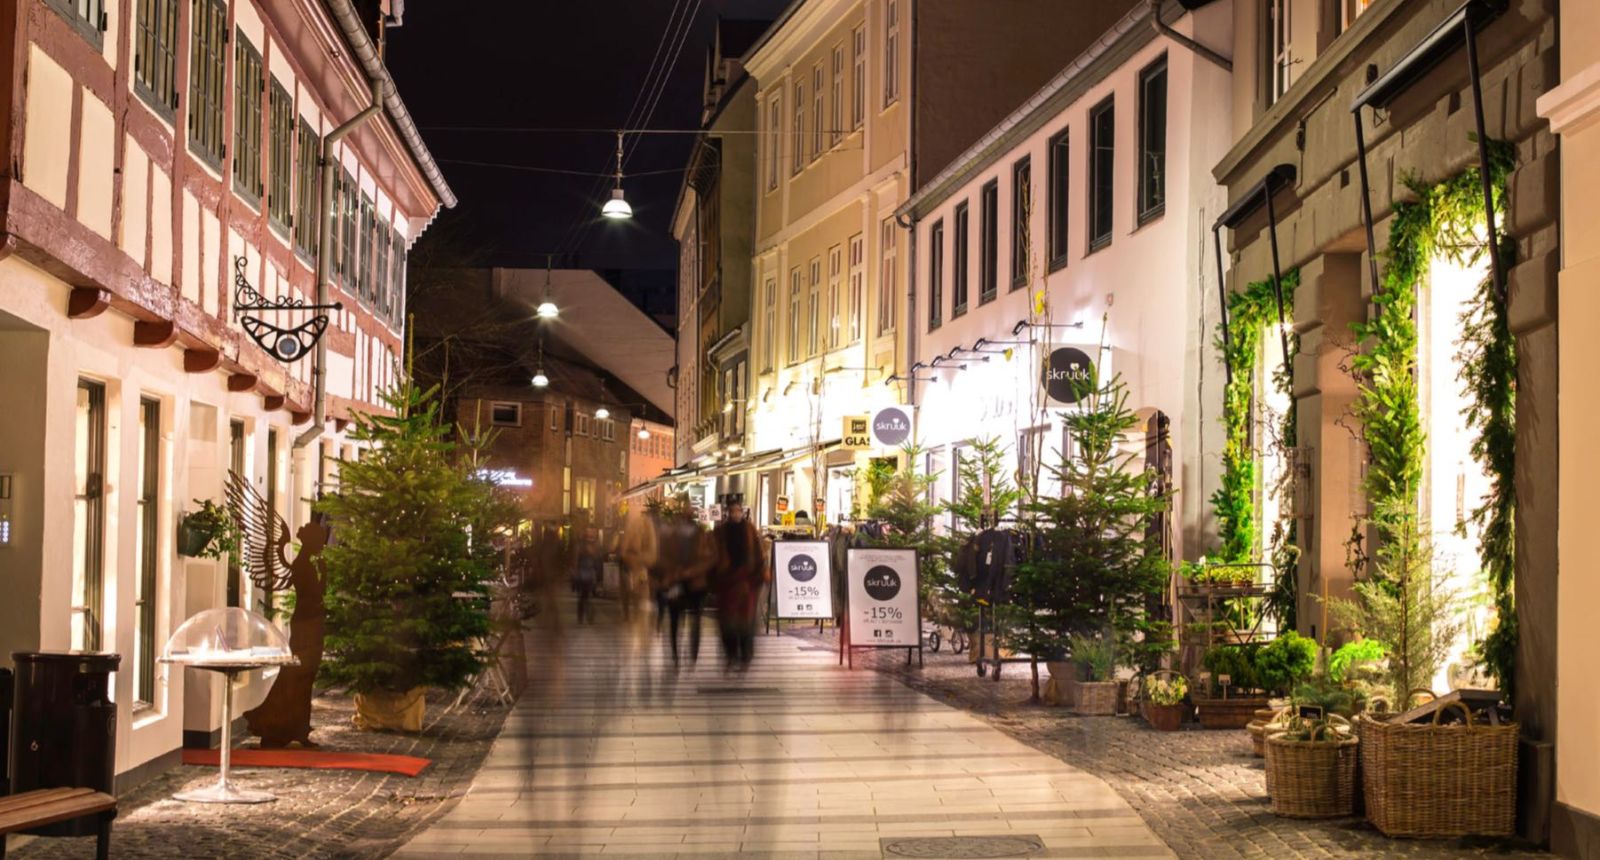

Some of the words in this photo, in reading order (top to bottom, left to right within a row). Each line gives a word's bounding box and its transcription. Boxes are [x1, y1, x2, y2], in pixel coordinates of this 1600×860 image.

[1047, 363, 1090, 380] skruuk
[876, 419, 907, 431] skruuk
[790, 563, 815, 572] skruuk
[866, 577, 898, 588] skruuk
[788, 586, 820, 597] -15%
[863, 606, 903, 620] -15%
